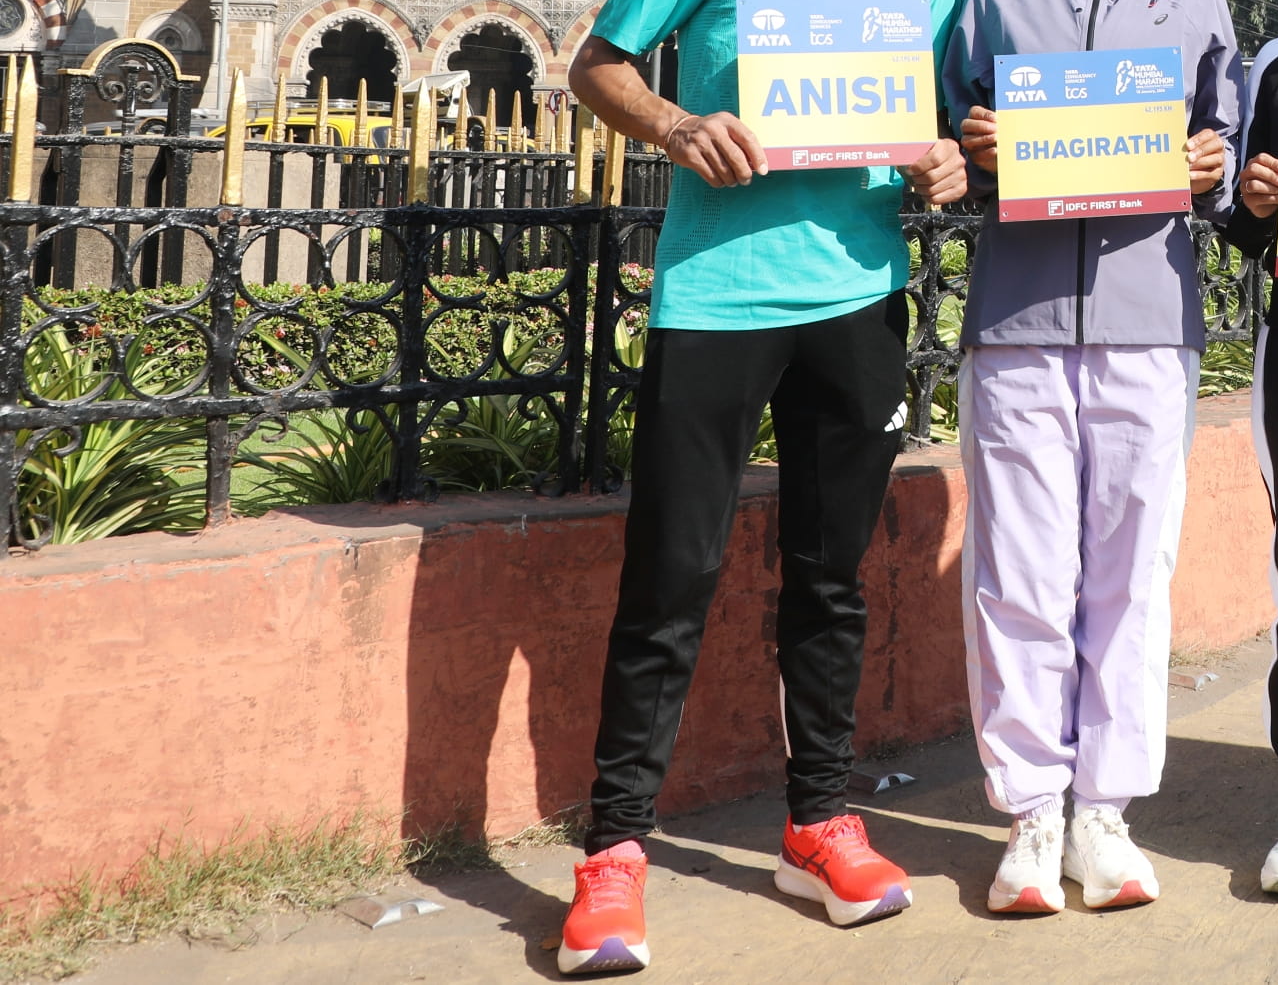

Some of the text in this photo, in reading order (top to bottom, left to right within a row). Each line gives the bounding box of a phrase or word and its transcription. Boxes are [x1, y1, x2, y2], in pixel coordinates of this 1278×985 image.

[883, 26, 922, 34] MARATHON
[747, 34, 792, 47] TATA
[809, 31, 833, 45] tcs
[1135, 70, 1162, 79] MUMBAI
[1136, 77, 1174, 85] MARATHON
[762, 76, 916, 116] ANISH
[1005, 90, 1047, 102] TATA
[1065, 86, 1087, 99] tcs
[1016, 134, 1170, 161] BHAGIRATHI
[811, 151, 890, 162] IDFC FIRST Bank
[1066, 200, 1142, 211] IDFC FIRST Bank
